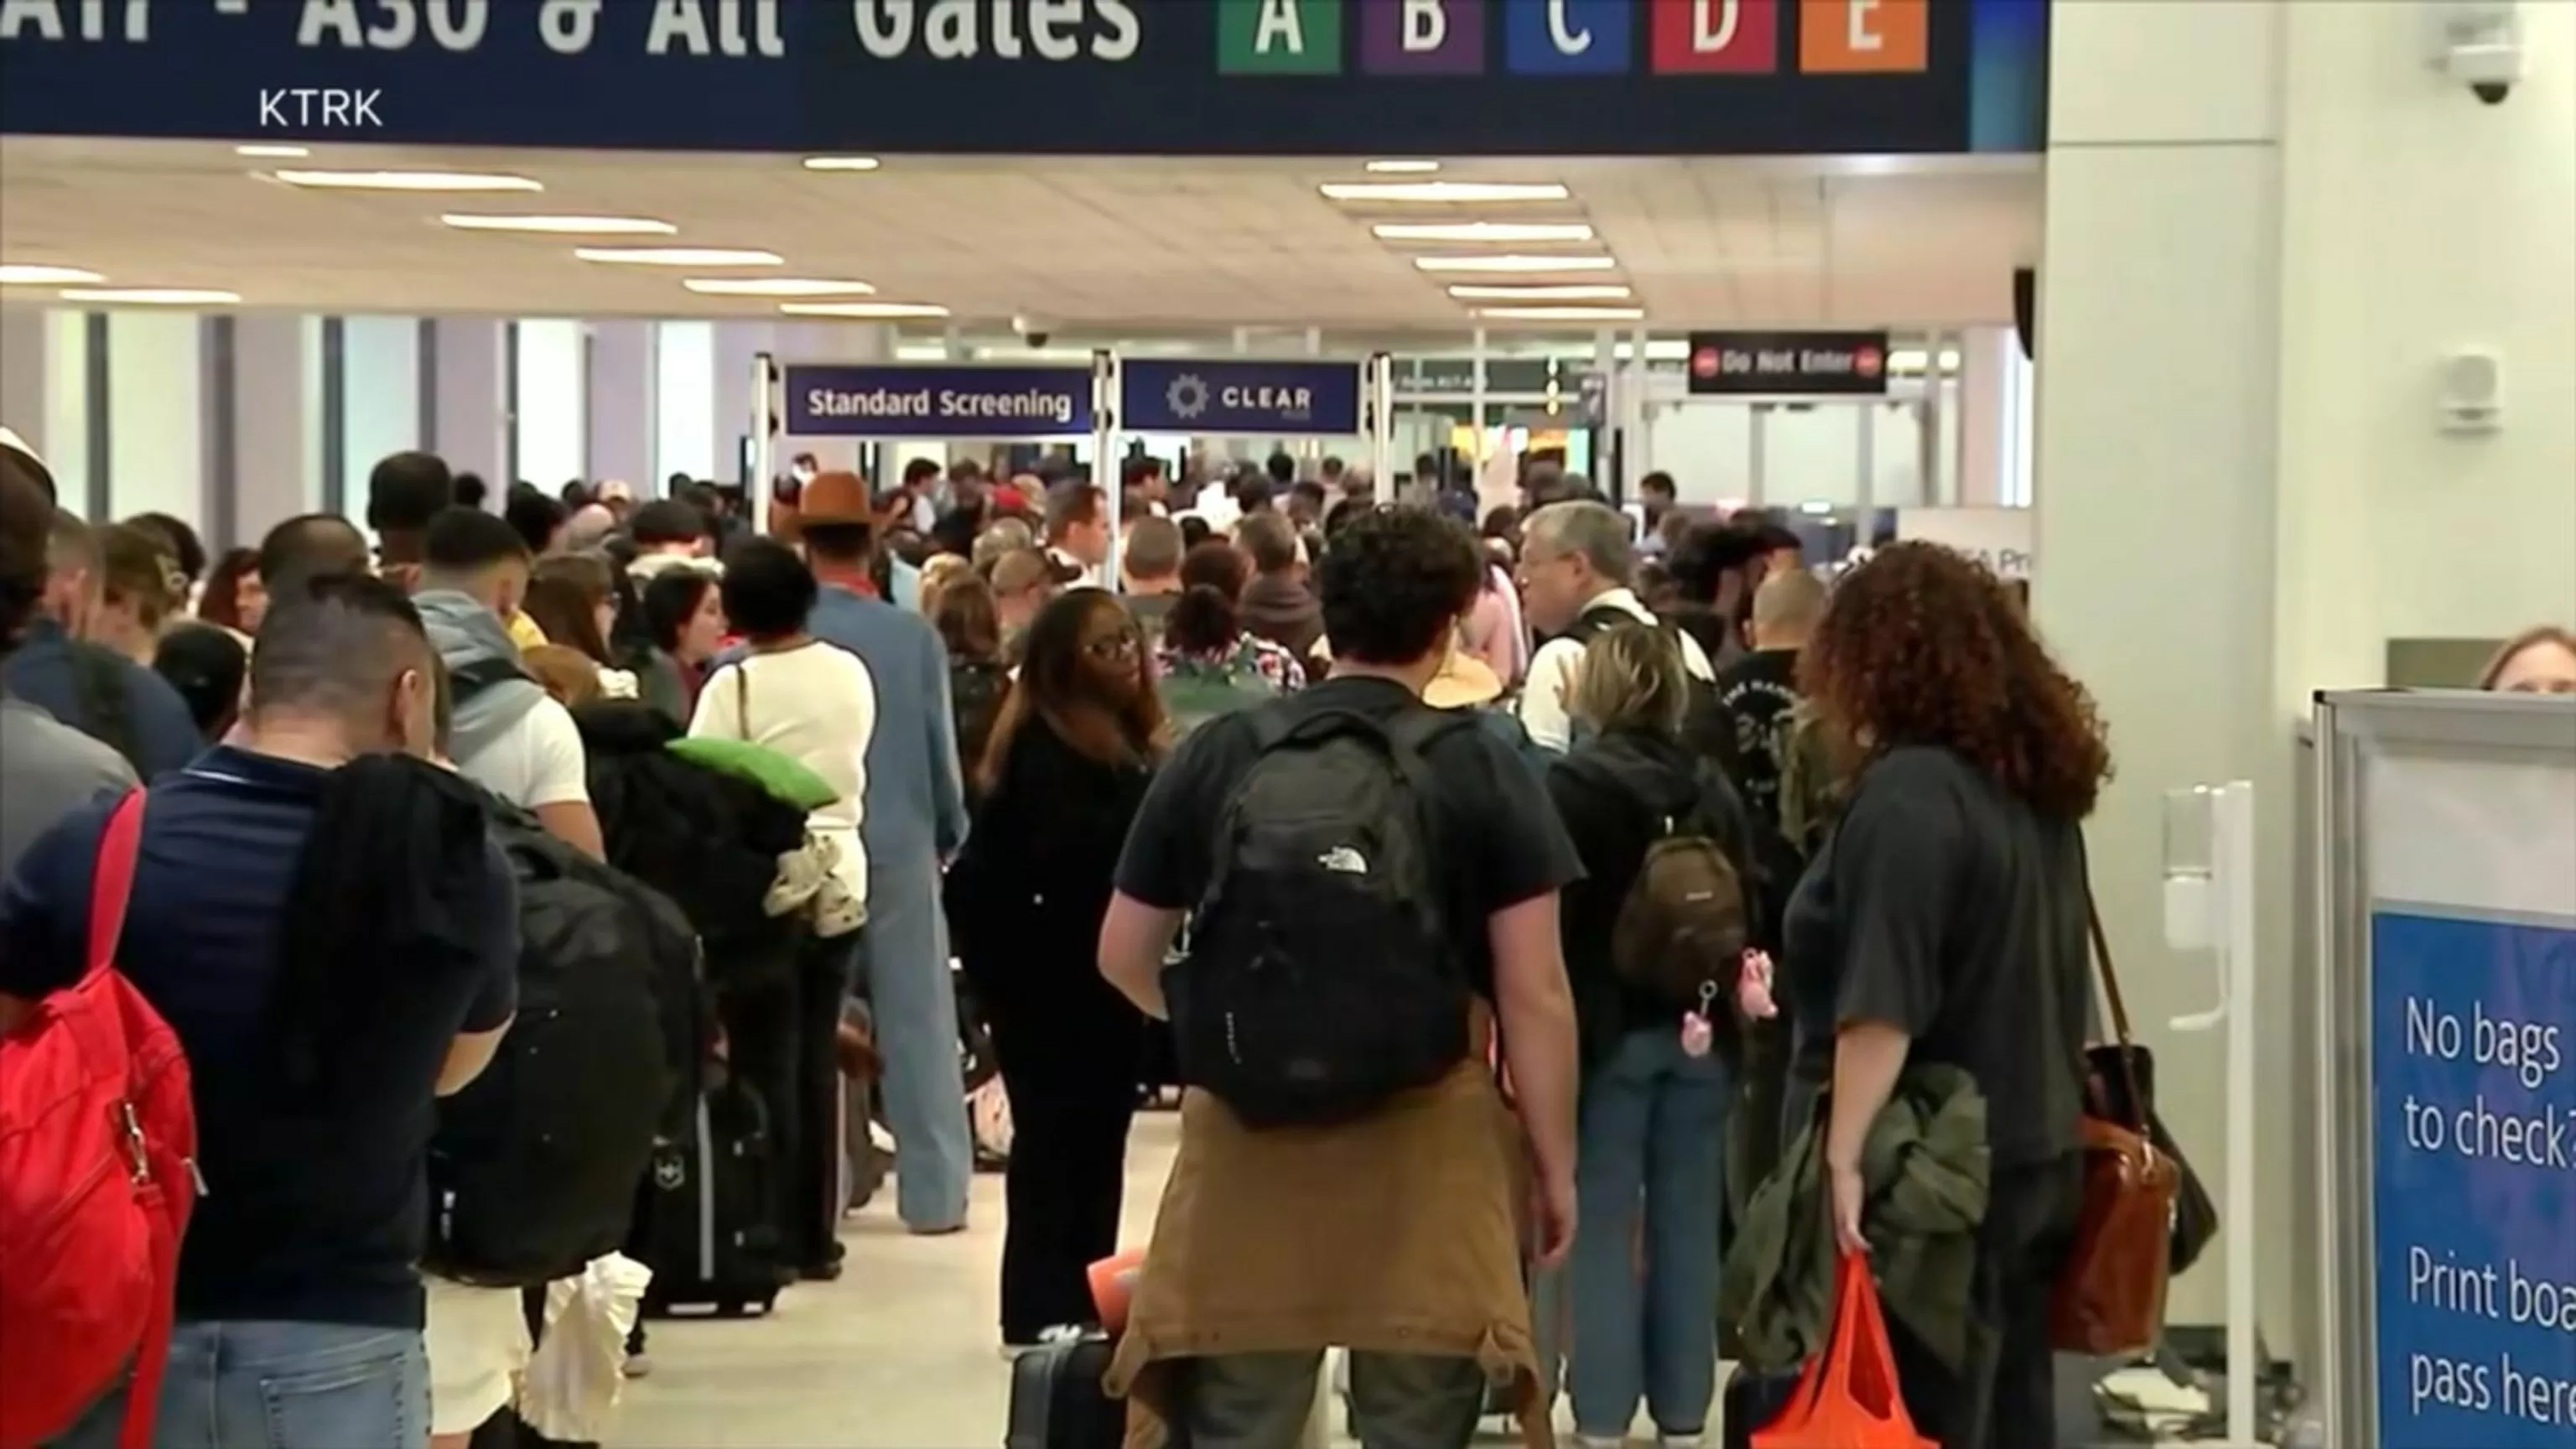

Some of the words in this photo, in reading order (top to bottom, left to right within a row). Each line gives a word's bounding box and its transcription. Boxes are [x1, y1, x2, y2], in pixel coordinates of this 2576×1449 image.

[853, 0, 1140, 60] Gates
[1255, 0, 1304, 54] A
[1403, 0, 1446, 52] B
[1548, 0, 1591, 55] C
[1693, 0, 1740, 53] D
[1722, 349, 1752, 373] Do
[1757, 349, 1794, 373] Not
[1800, 349, 1853, 372] Enter
[808, 389, 930, 417] Standard
[939, 389, 1072, 423] Screening
[1221, 386, 1312, 408] CLEAR
[2407, 995, 2462, 1058] No
[2474, 1000, 2561, 1088] bags
[2404, 1093, 2444, 1150] to
[2409, 1245, 2499, 1318] Print
[2509, 1259, 2576, 1332] boa
[2411, 1353, 2492, 1416] pass
